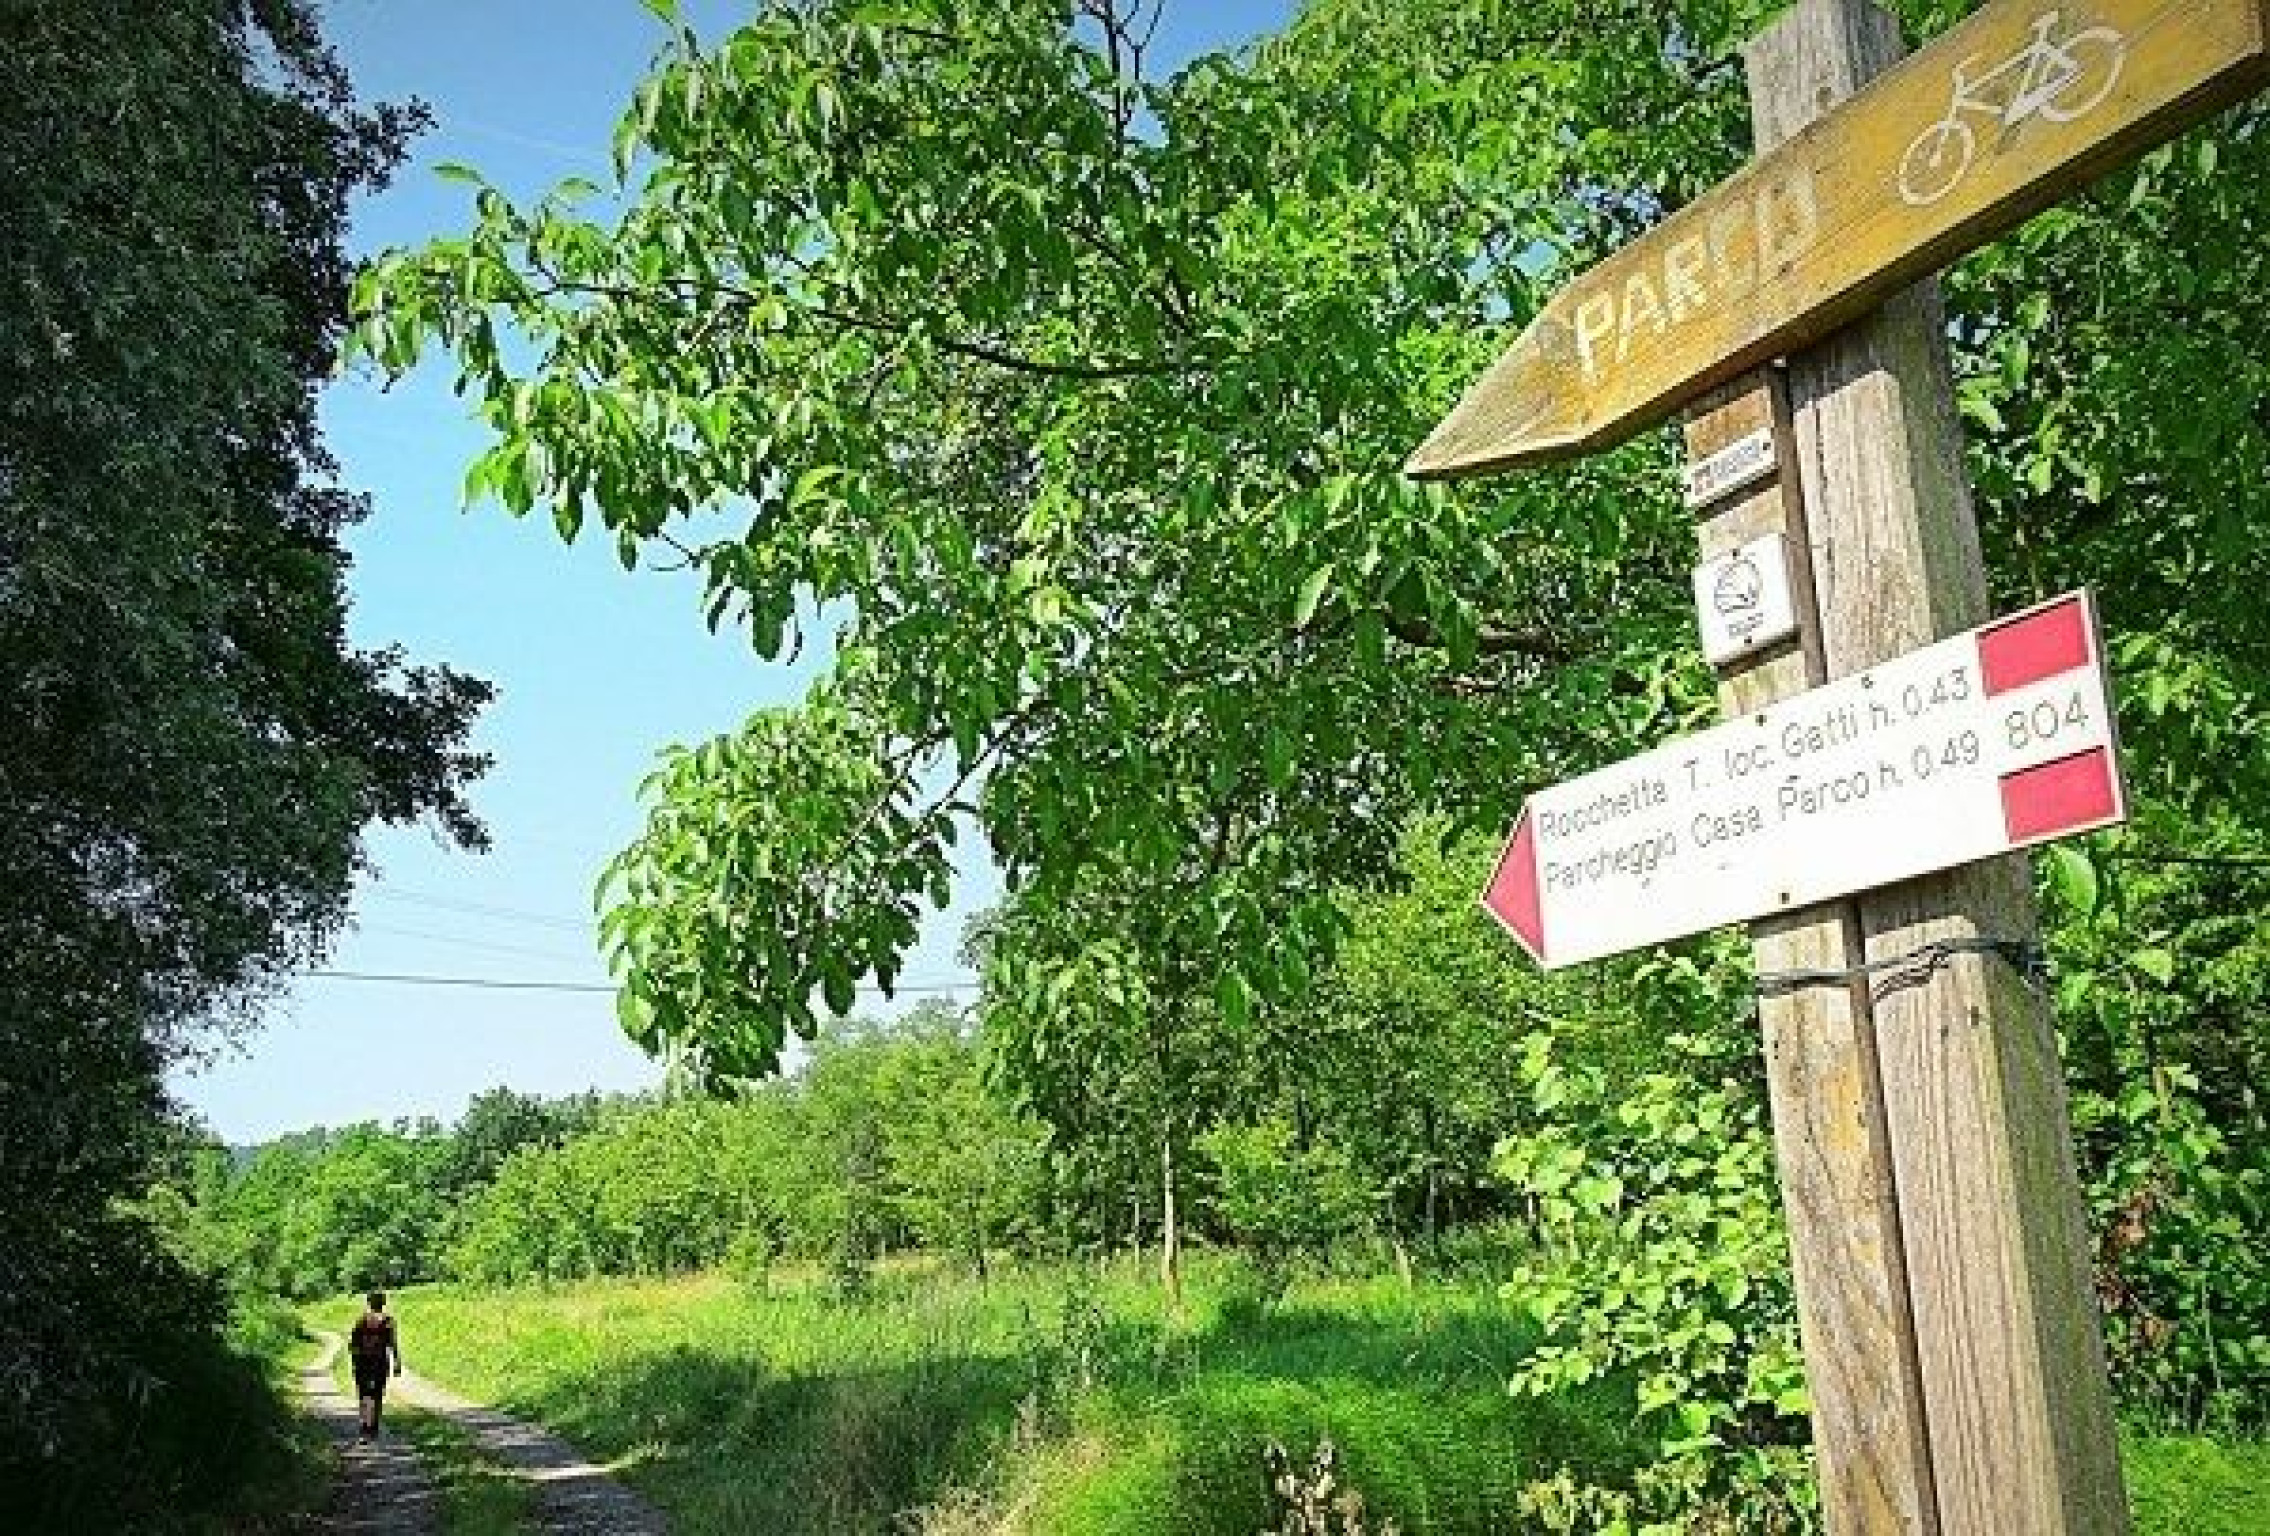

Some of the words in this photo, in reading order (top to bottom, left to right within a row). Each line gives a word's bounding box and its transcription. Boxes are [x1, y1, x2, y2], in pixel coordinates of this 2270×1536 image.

[1575, 168, 1817, 384] PARCO
[1540, 777, 1668, 838] Rocchetta
[1683, 756, 1711, 791] T.
[1781, 702, 1859, 758] Gatti
[1868, 702, 1897, 731] h.
[1902, 665, 1972, 717] 0.43
[2004, 690, 2090, 750] 804
[1543, 831, 1677, 893] Parcheggio
[1690, 805, 1764, 849] Casa
[1777, 770, 1870, 822] Parco
[1879, 761, 1904, 790] h.
[1910, 729, 1980, 780] 0.49
